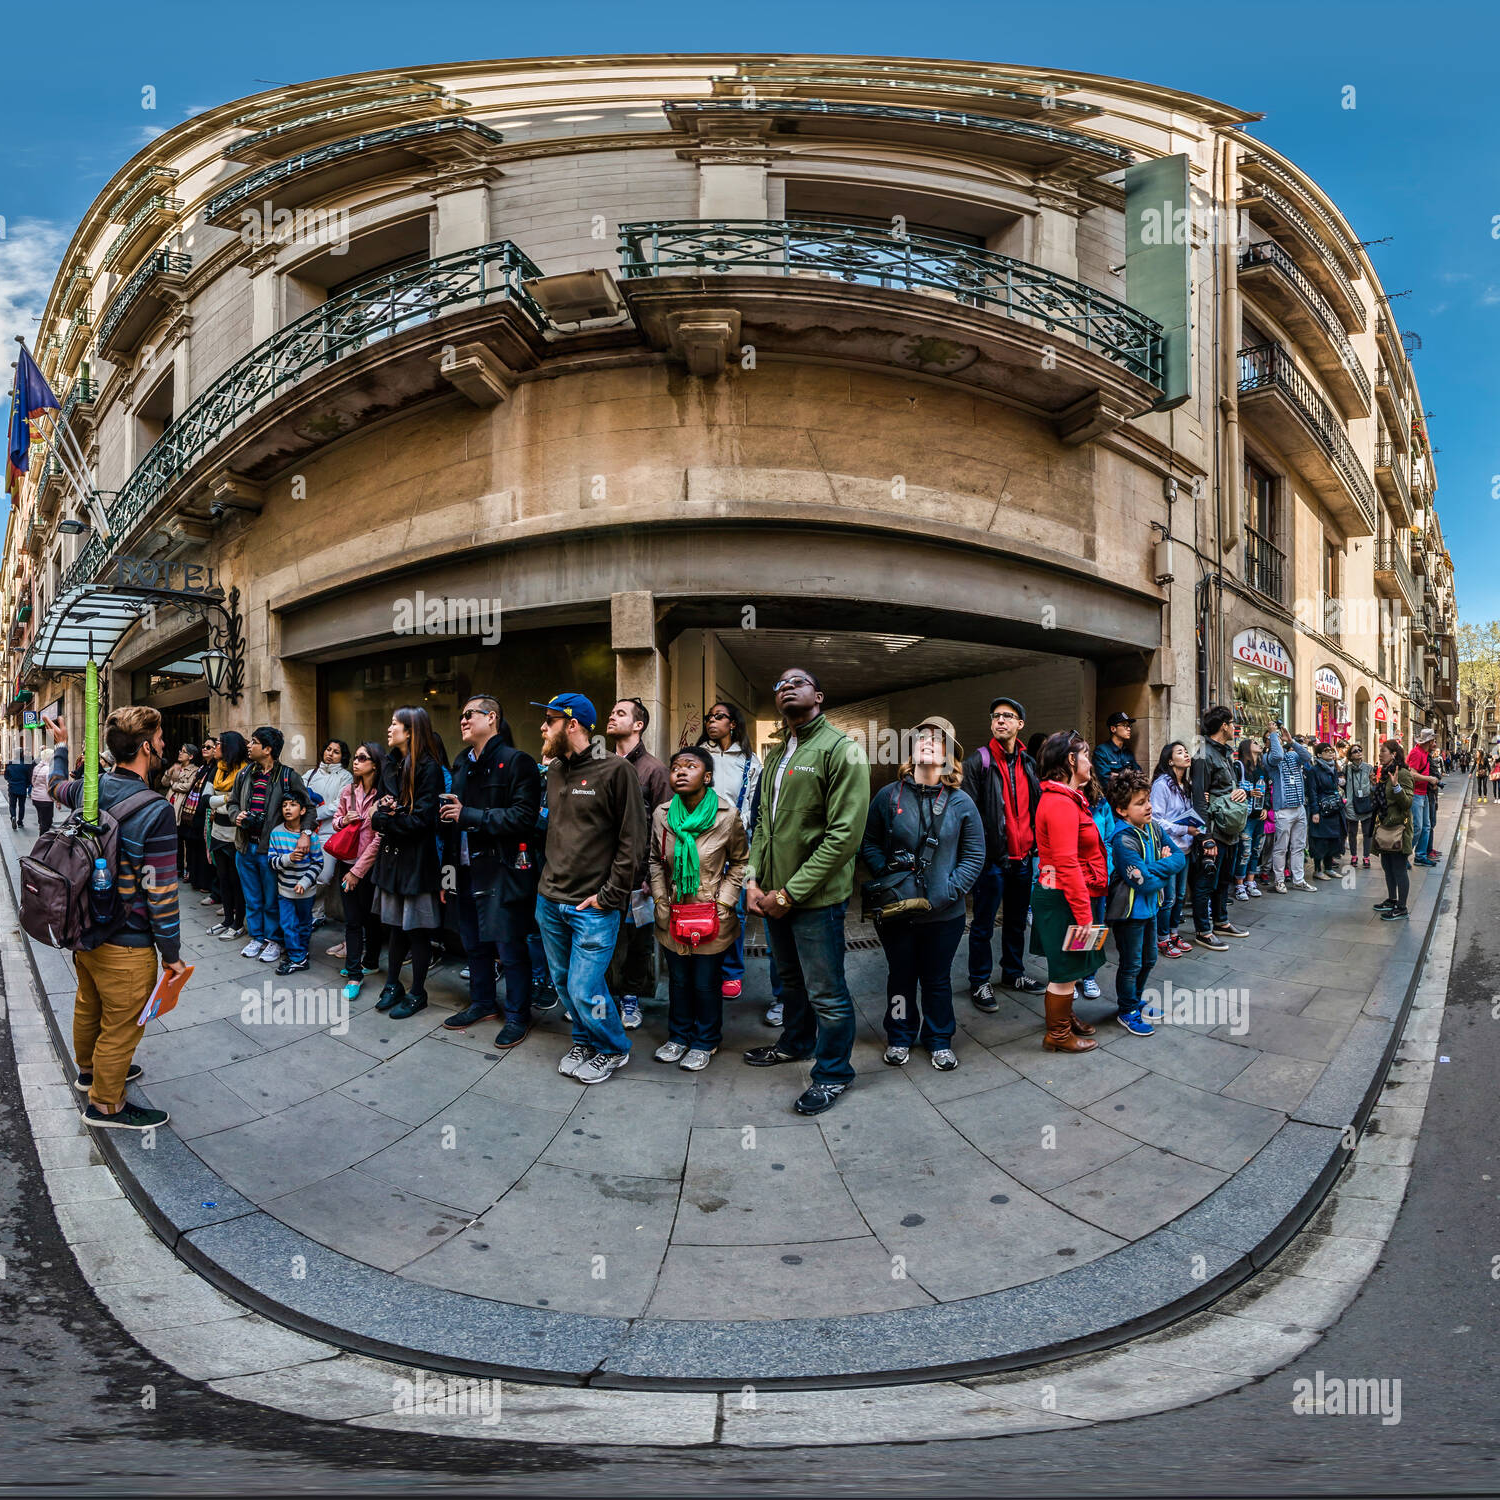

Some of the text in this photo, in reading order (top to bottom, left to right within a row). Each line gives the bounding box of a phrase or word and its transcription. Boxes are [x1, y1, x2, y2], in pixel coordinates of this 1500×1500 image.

[1259, 640, 1283, 658] ART
[1239, 646, 1288, 675] GAUDÍ
[1324, 673, 1338, 686] ART
